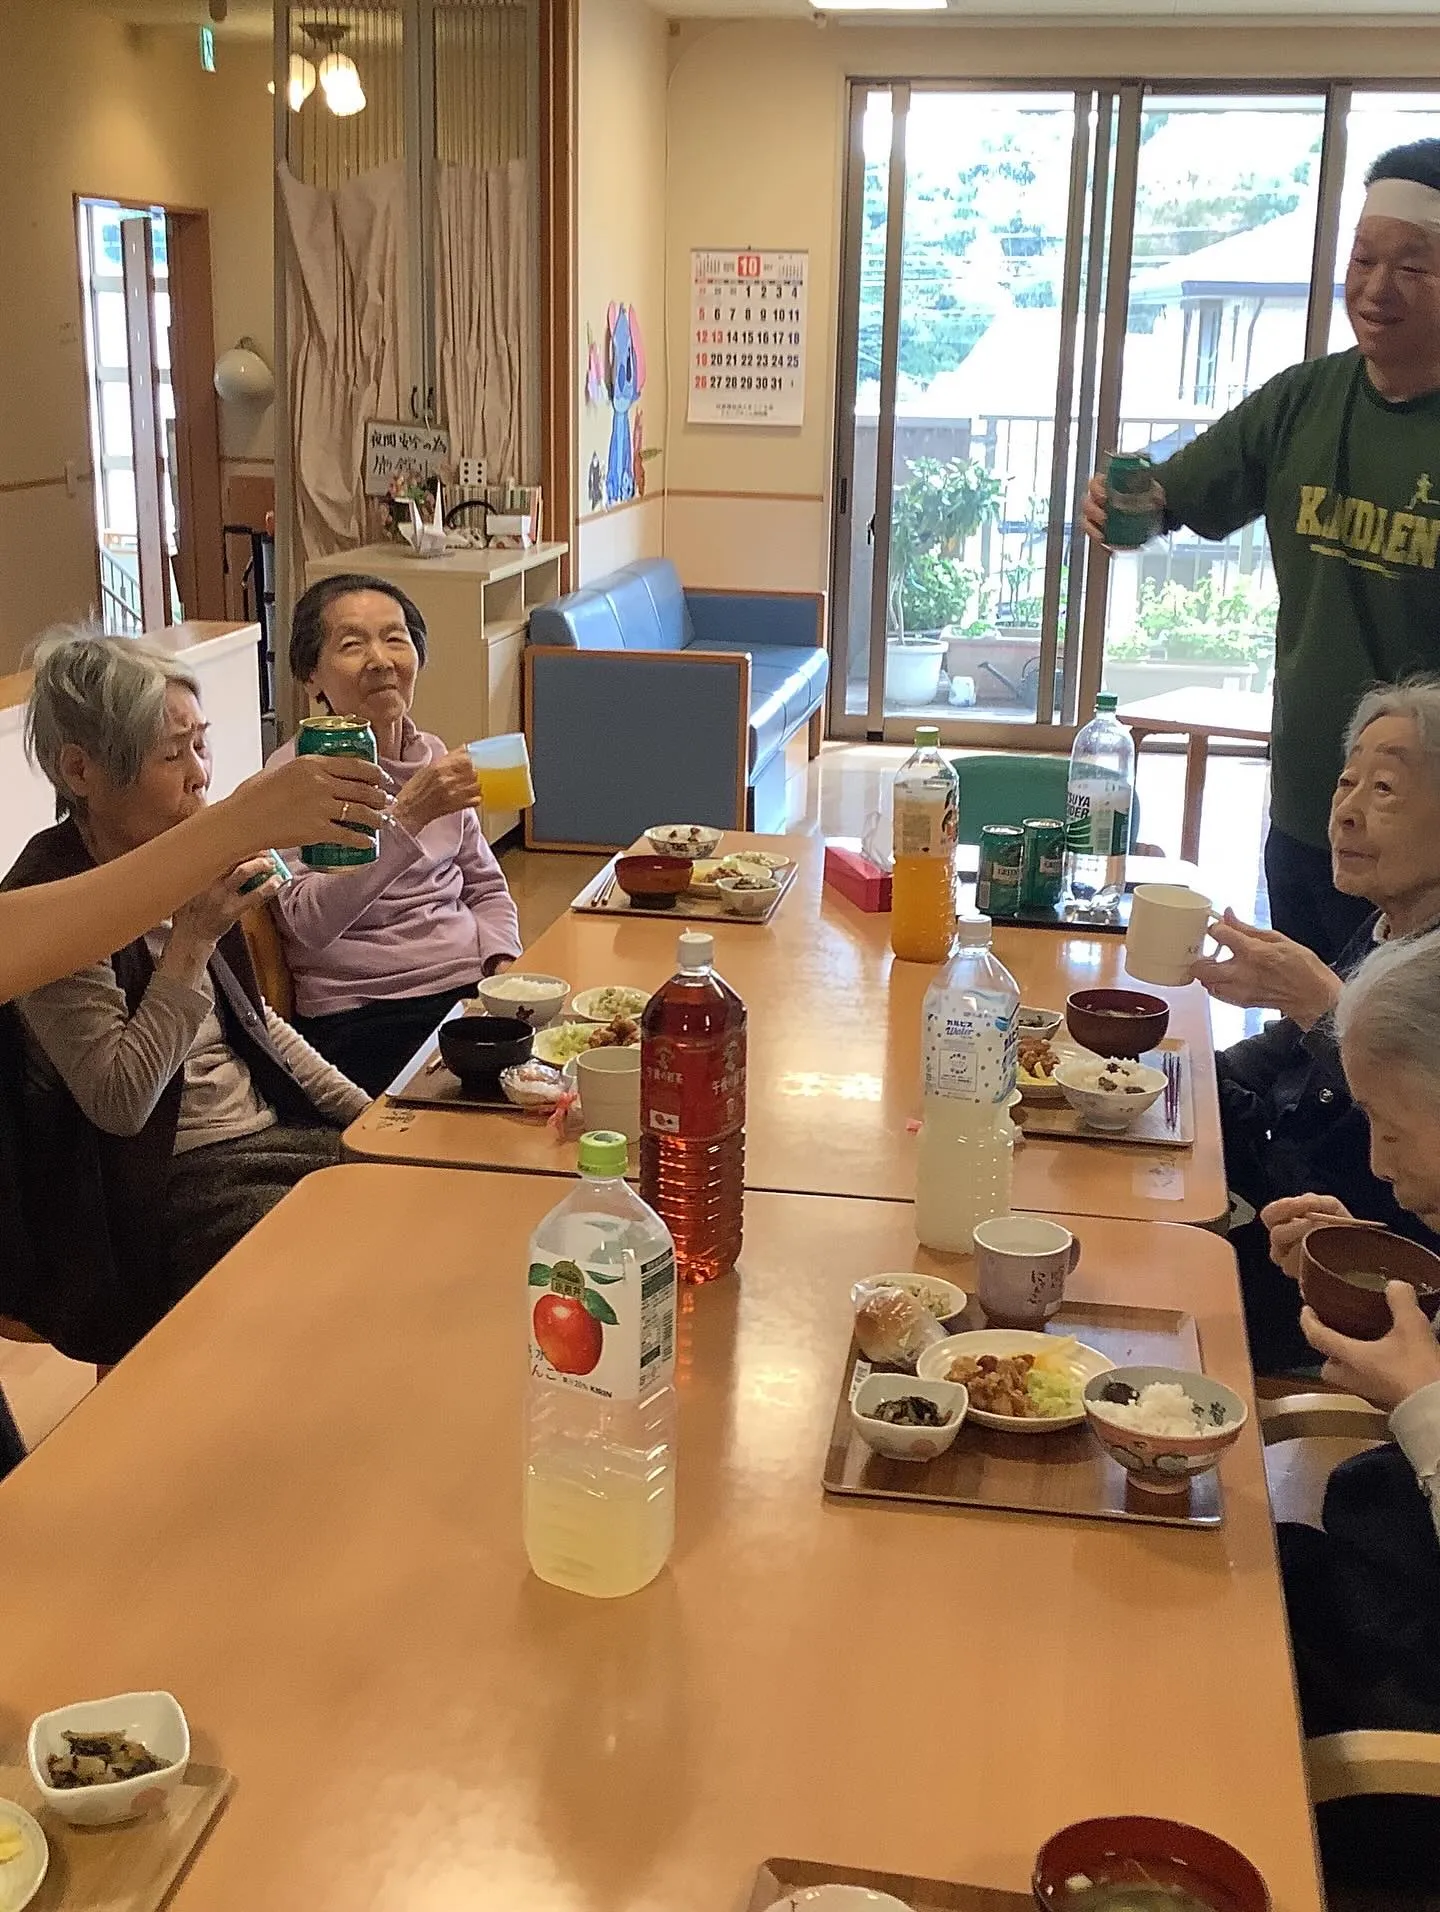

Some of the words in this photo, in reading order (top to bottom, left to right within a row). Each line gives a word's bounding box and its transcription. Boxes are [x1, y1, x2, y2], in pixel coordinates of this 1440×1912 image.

[740, 256, 758, 276] 10
[773, 308, 785, 322] 10
[788, 309, 800, 322] 11
[696, 330, 708, 343] 12
[711, 331, 723, 343] 13
[726, 330, 739, 344] 14
[742, 331, 754, 345] 15
[757, 331, 769, 345] 16
[772, 331, 784, 345] 17
[788, 332, 800, 345] 18
[696, 352, 708, 367] 19
[710, 353, 723, 366] 20
[725, 353, 737, 367] 21
[741, 354, 753, 367] 22
[756, 354, 769, 367] 23
[771, 354, 784, 368] 24
[786, 355, 799, 368] 25
[695, 375, 707, 389] 26
[710, 375, 722, 389] 27
[725, 376, 738, 389] 28
[740, 376, 753, 390] 29
[755, 377, 768, 390] 30
[770, 376, 782, 391] 31
[946, 1019, 973, 1028] カルピス
